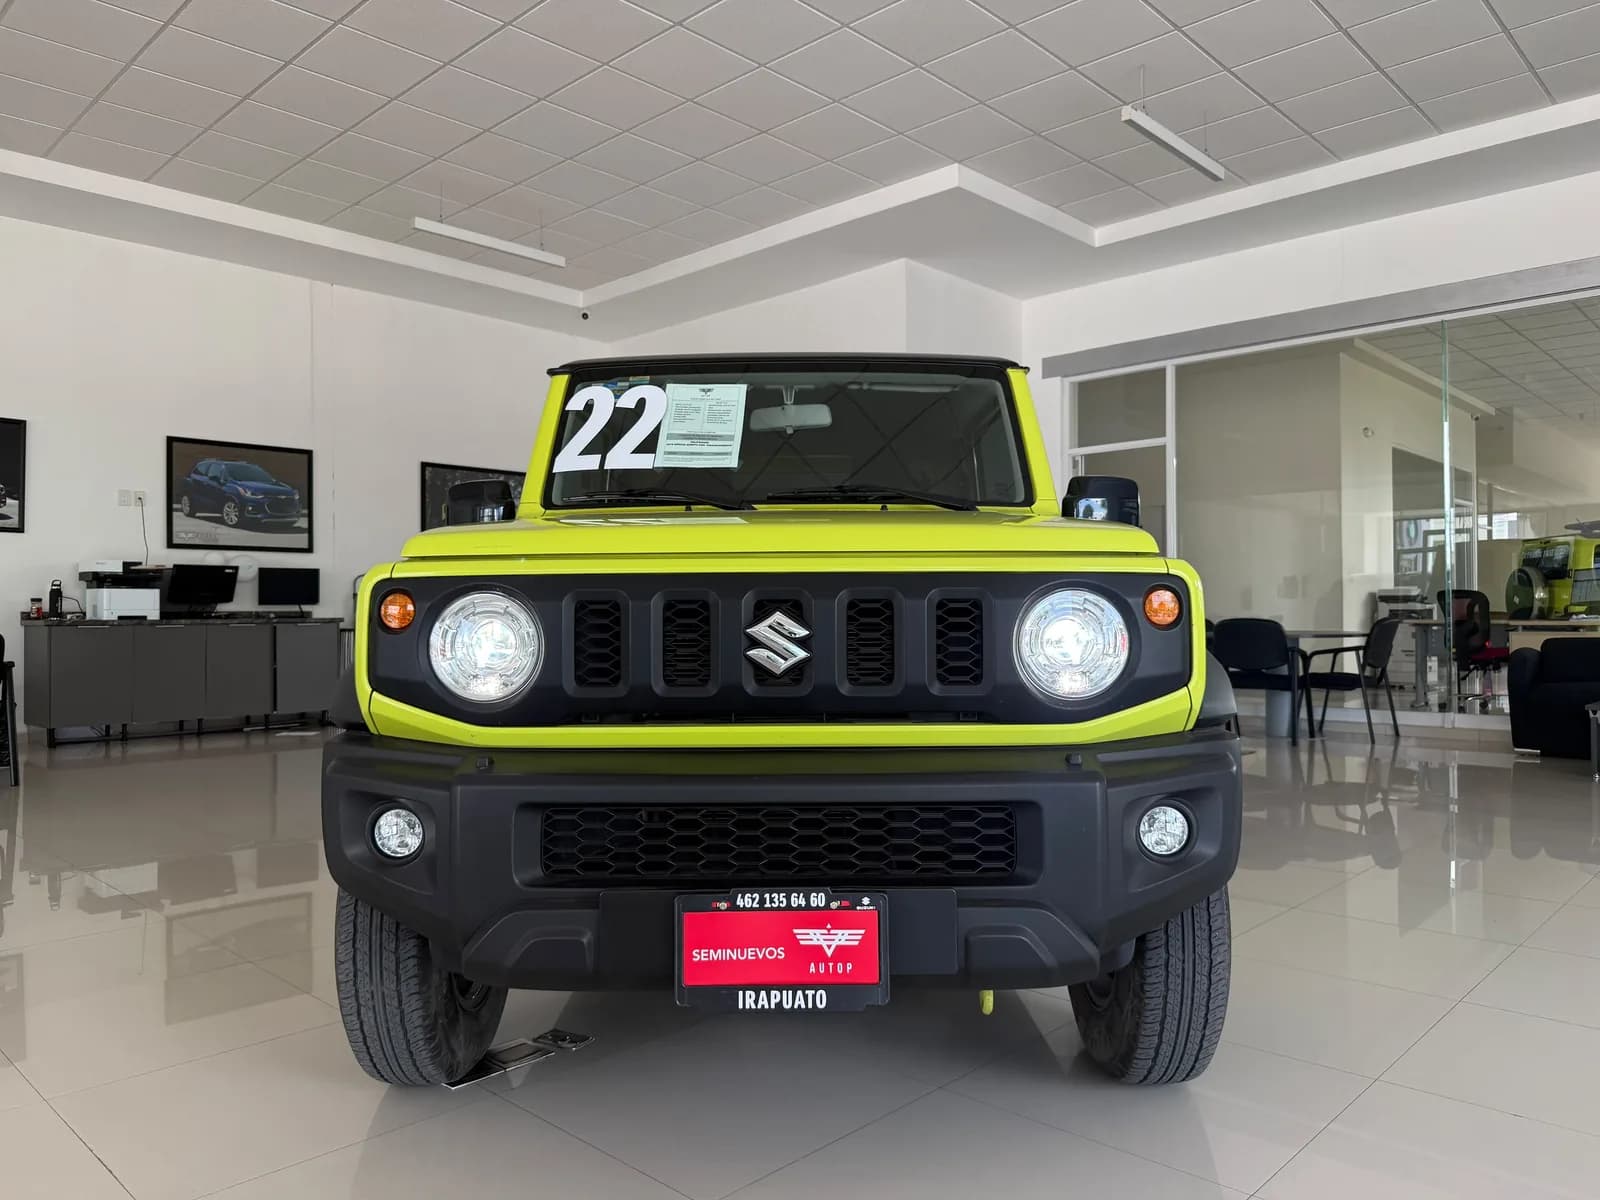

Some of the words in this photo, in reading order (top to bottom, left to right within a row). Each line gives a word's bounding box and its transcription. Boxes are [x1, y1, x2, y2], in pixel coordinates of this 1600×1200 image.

[552, 384, 668, 474] 22
[736, 892, 760, 908] 462
[763, 892, 787, 908] 135
[790, 892, 807, 908] 64
[809, 892, 826, 908] 60
[692, 946, 786, 962] SEMINUEVOS
[809, 961, 854, 974] AUTOP
[737, 989, 828, 1011] IRAPUATO
